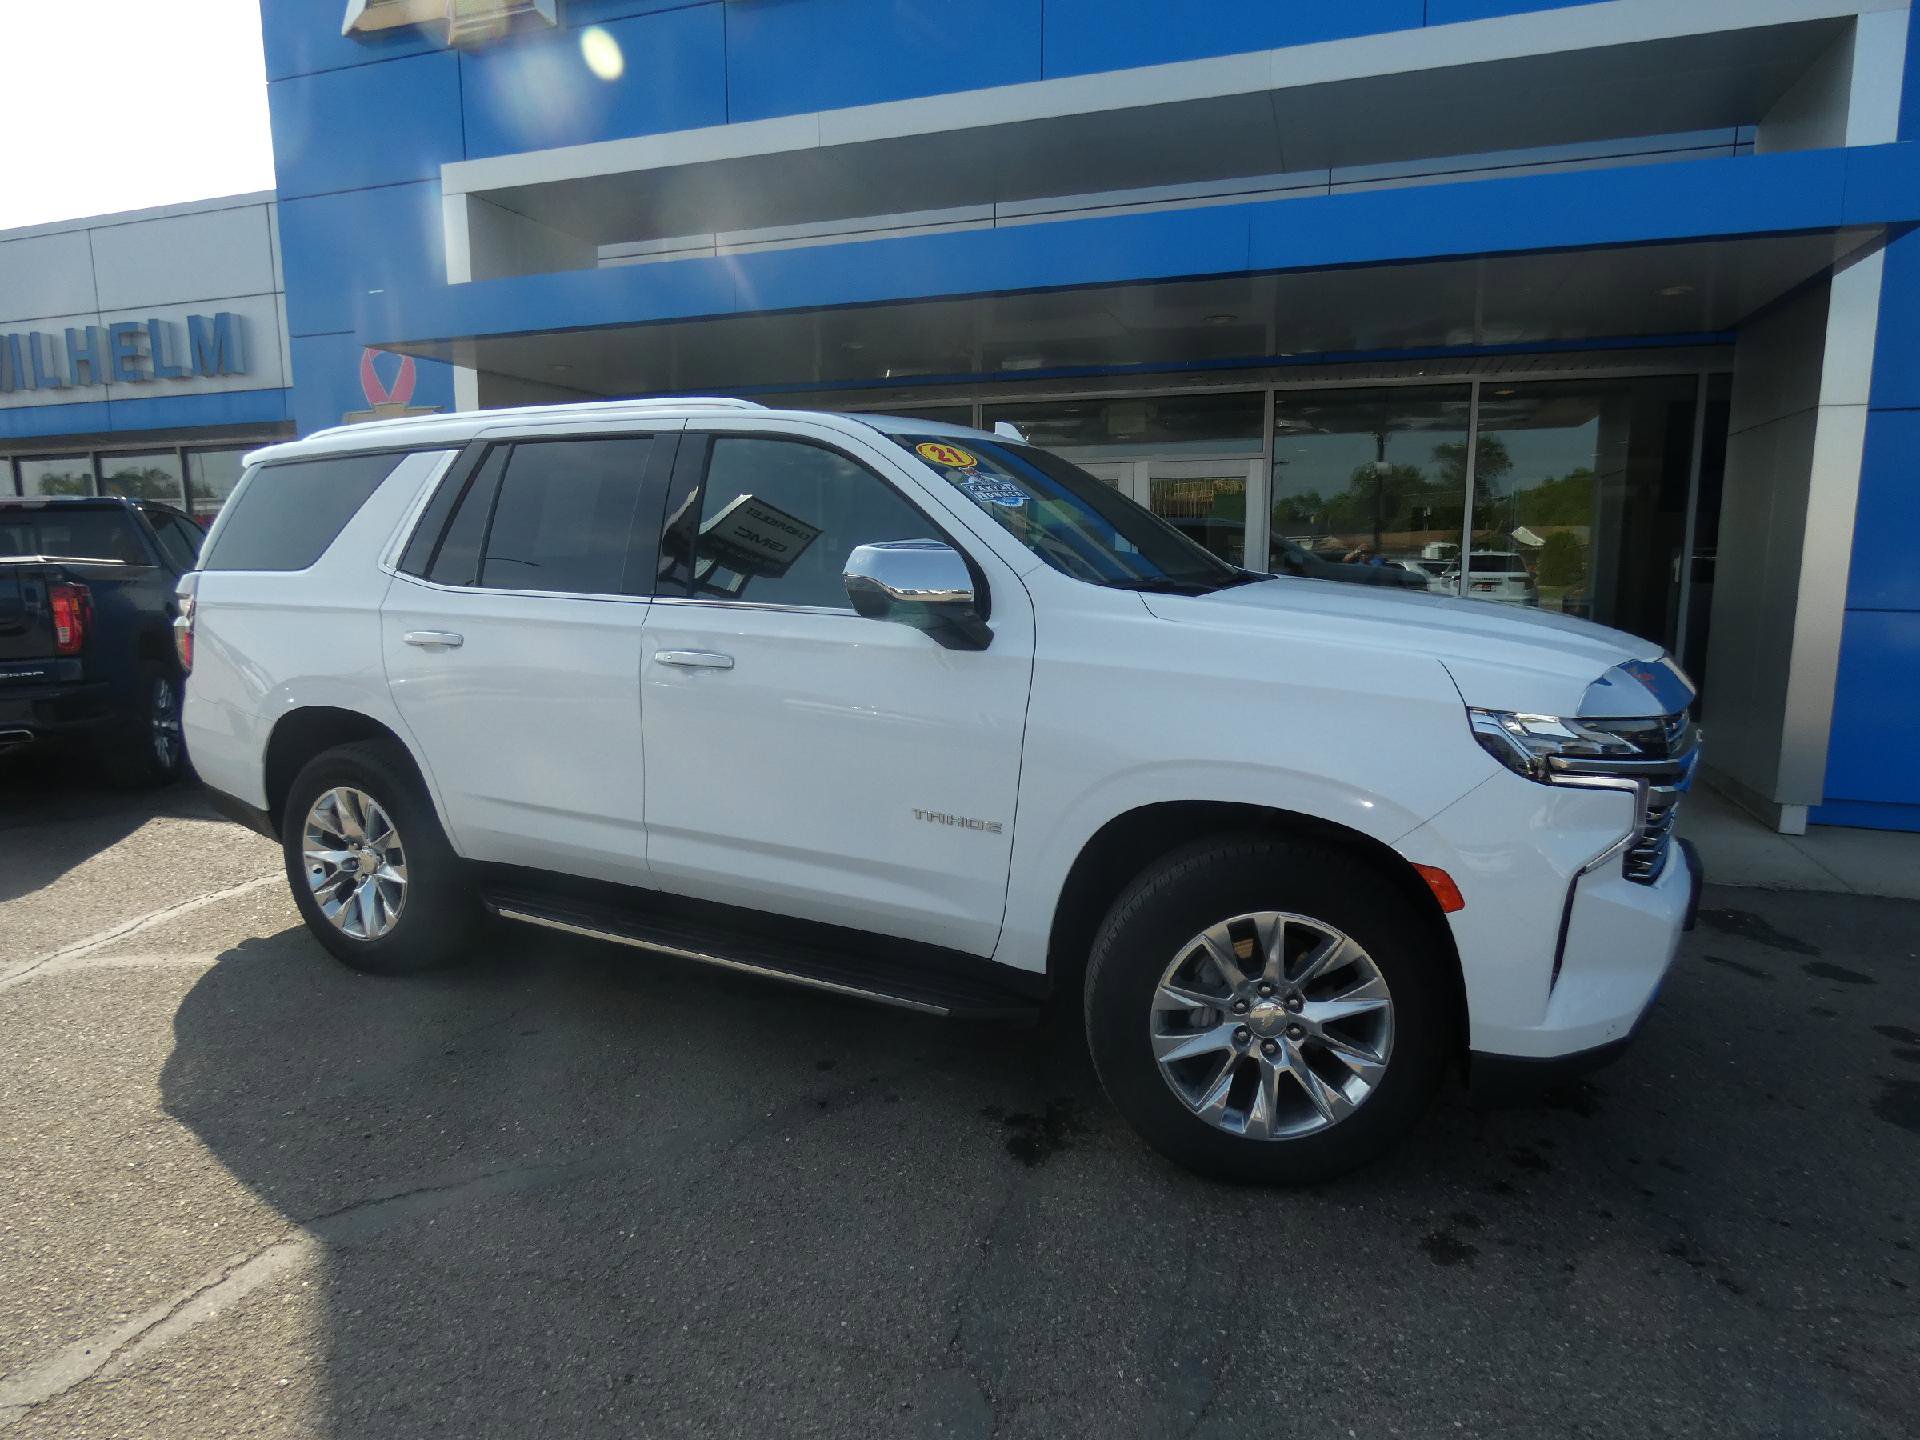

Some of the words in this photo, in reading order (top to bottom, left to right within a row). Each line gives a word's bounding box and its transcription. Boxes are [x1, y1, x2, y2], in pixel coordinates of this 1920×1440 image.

[0, 312, 243, 391] ILHELM
[929, 445, 965, 463] 21
[912, 808, 1003, 834] TAHOE
